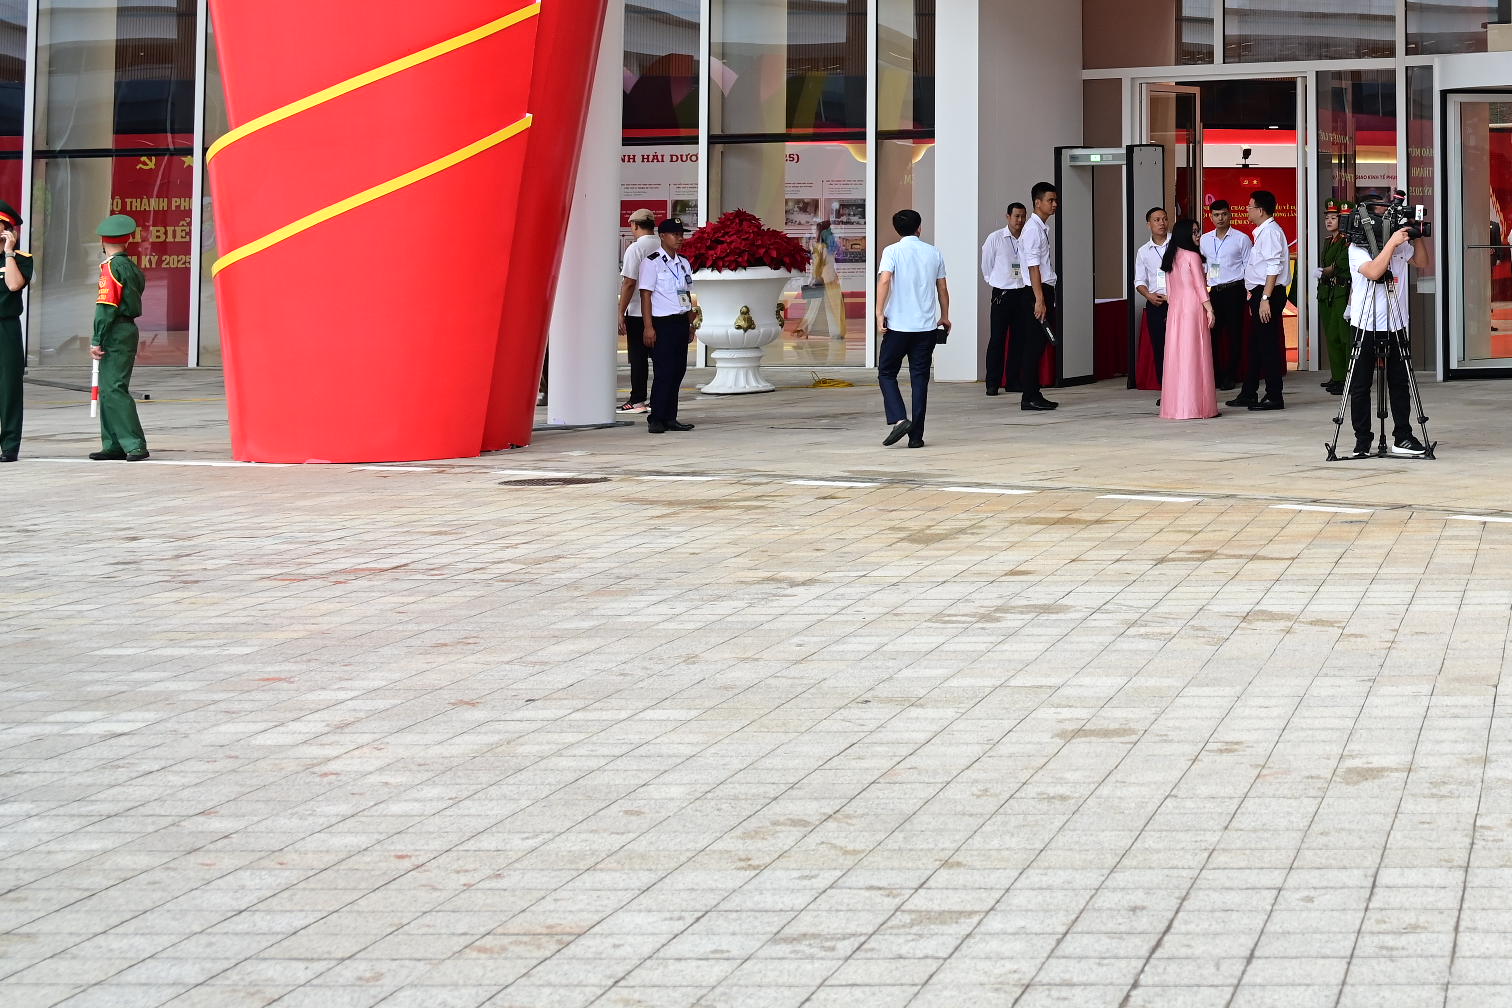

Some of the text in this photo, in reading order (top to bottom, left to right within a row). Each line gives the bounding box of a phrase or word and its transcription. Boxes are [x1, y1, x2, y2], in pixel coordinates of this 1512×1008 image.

[640, 152, 665, 163] HẢI
[110, 195, 122, 214] Ộ
[125, 195, 168, 211] THÀNH
[149, 217, 192, 242] BIỂ
[141, 252, 159, 269] KỲ
[162, 255, 191, 268] 2025
